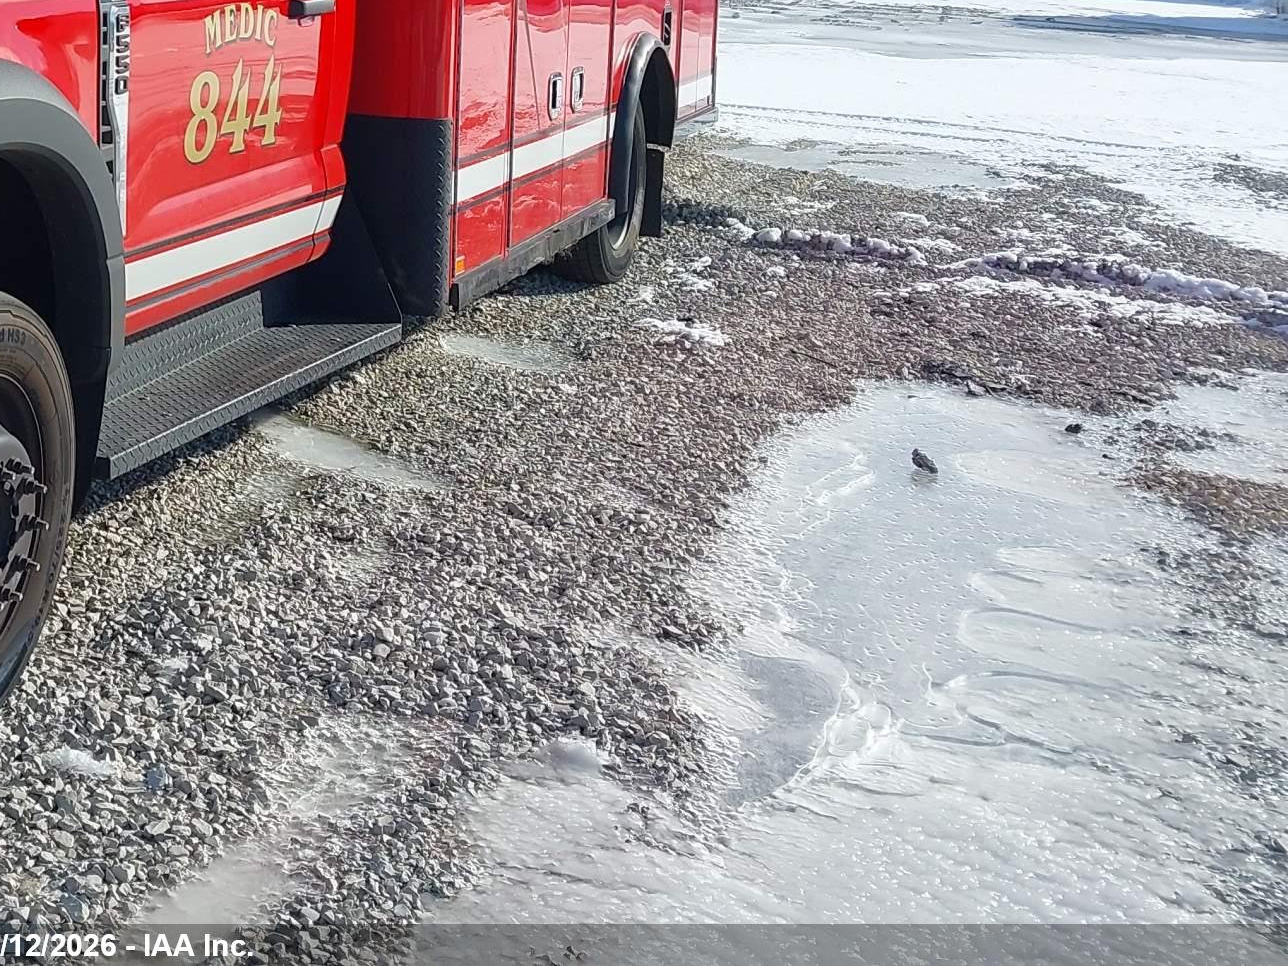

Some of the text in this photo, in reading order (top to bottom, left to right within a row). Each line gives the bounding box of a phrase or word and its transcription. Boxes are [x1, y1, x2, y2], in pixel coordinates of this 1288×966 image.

[204, 2, 278, 54] MEDIC
[184, 54, 282, 164] 844
[7, 327, 27, 346] HS3
